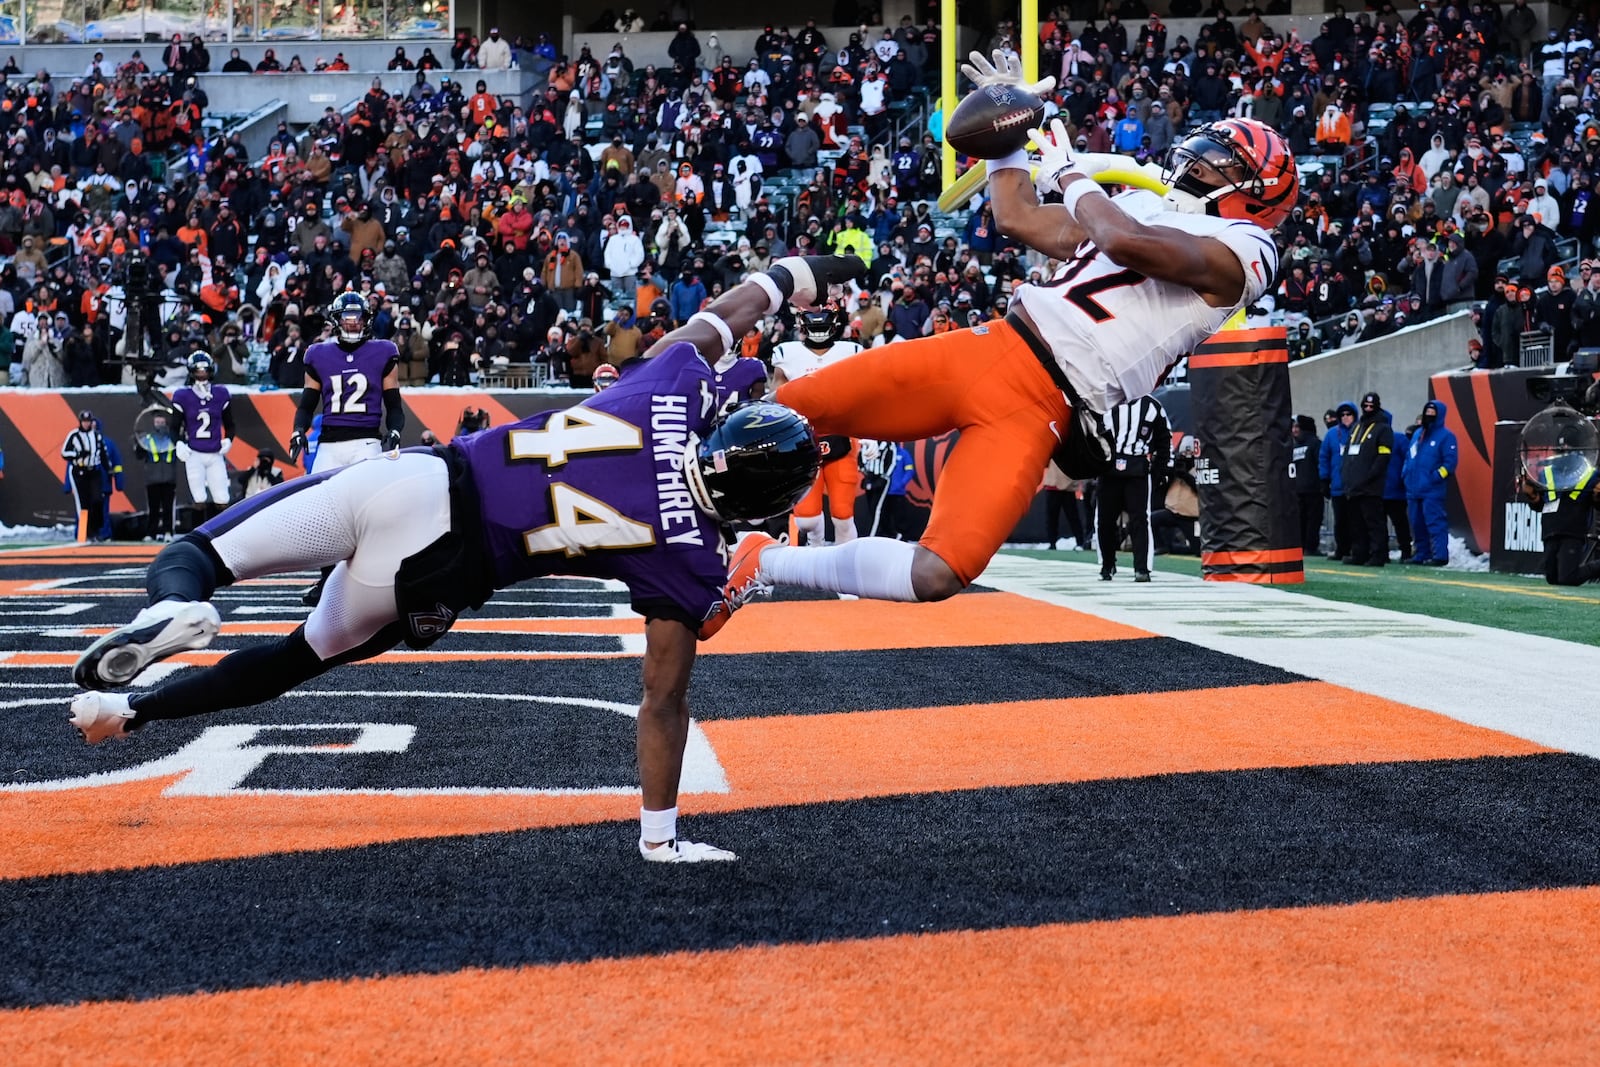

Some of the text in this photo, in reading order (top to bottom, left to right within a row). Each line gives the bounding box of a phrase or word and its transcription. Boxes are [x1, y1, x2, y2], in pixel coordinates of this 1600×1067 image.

[477, 98, 485, 111] 9
[898, 156, 912, 170] 22
[1319, 283, 1329, 302] 9
[329, 372, 369, 414] 12
[195, 411, 212, 438] 2
[509, 404, 656, 558] 44
[652, 395, 703, 546] HUMPHREY
[1504, 502, 1544, 553] BENGAL
